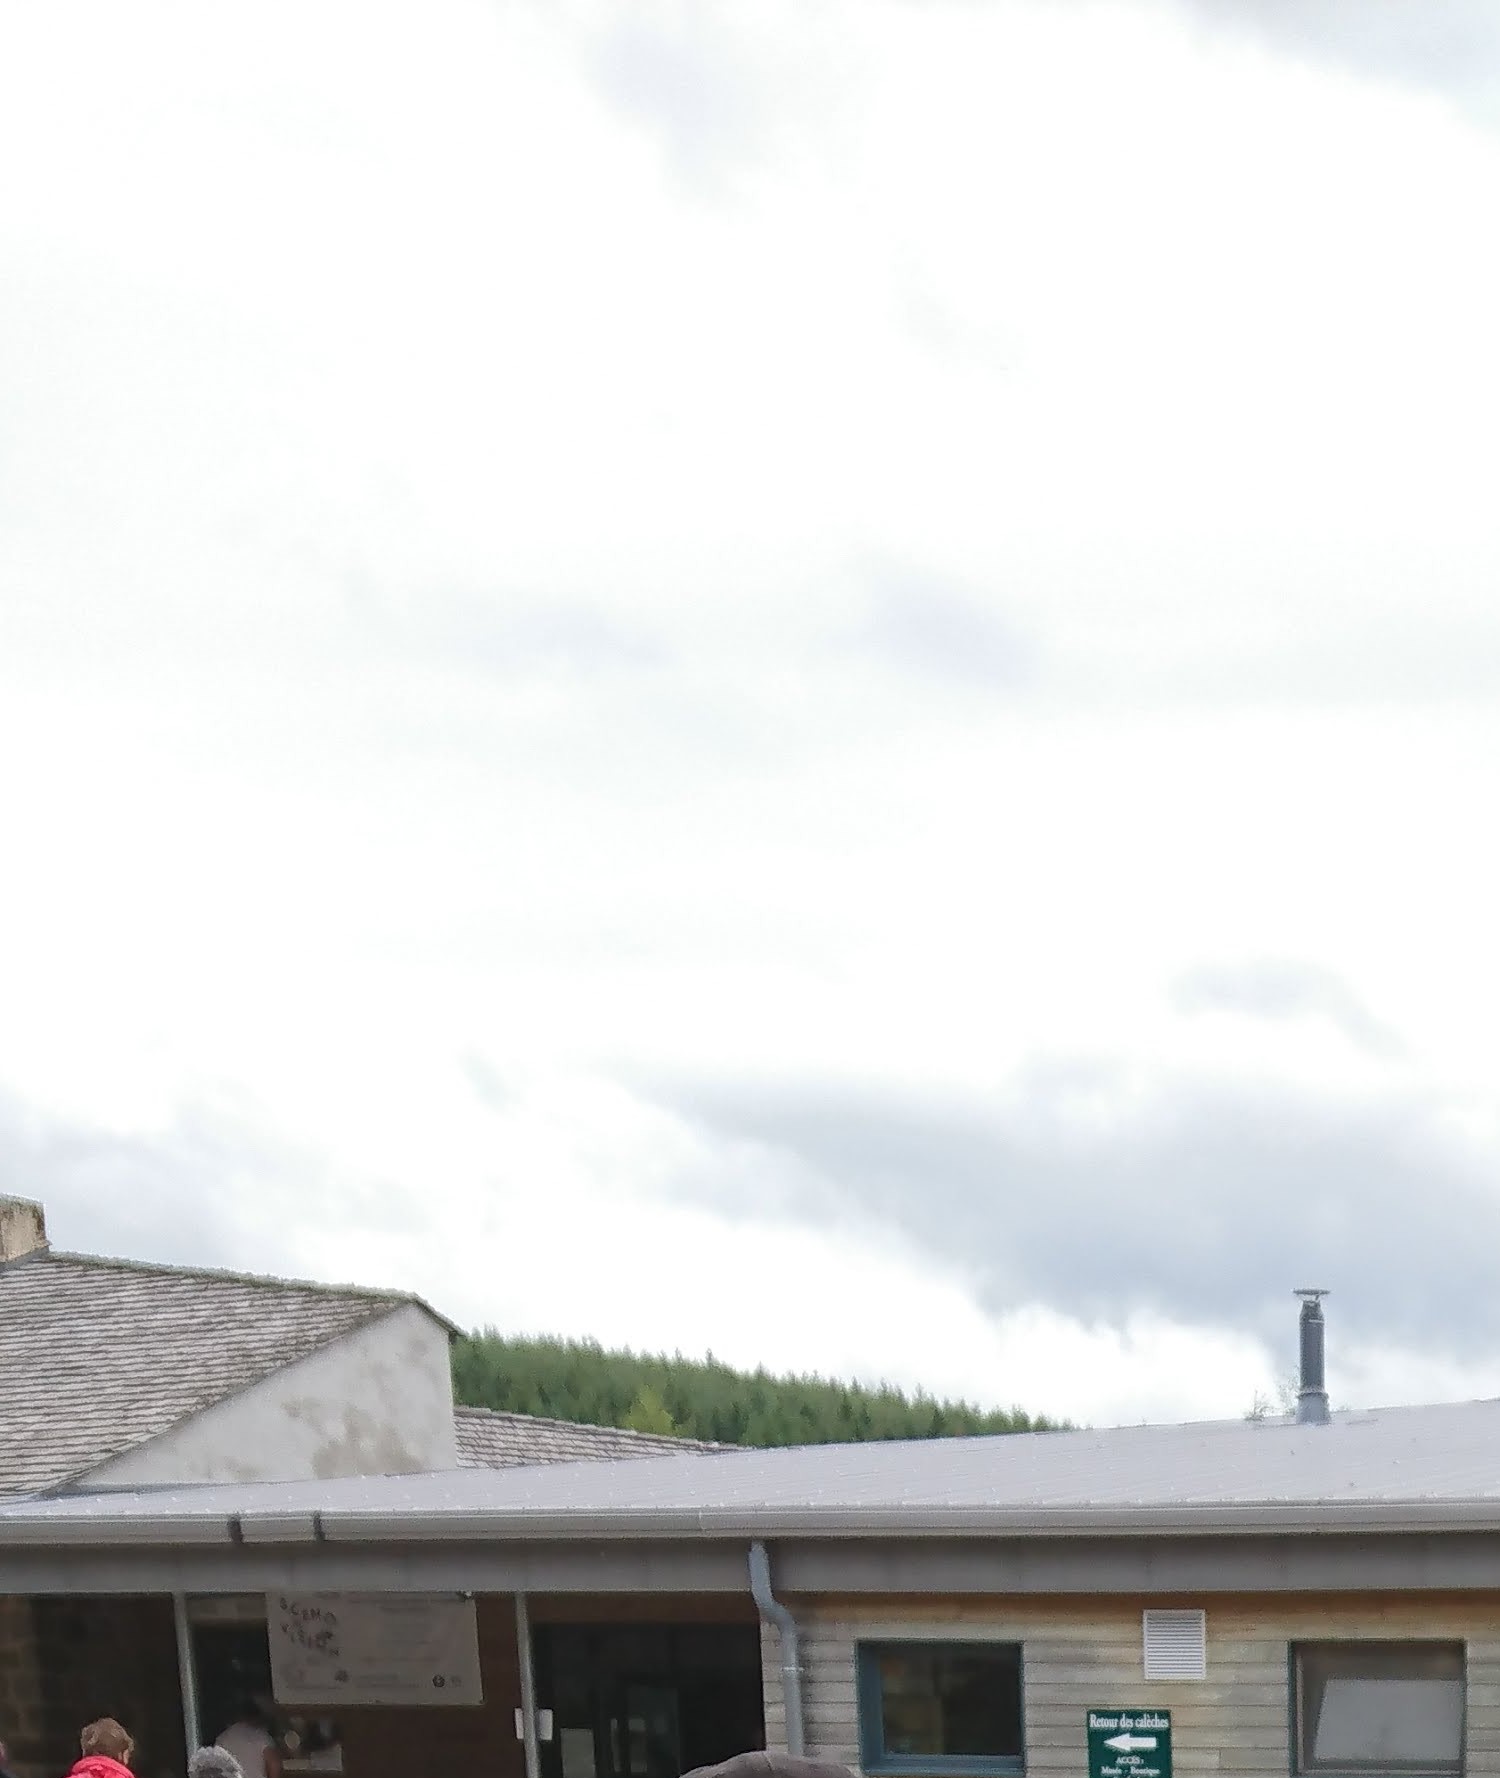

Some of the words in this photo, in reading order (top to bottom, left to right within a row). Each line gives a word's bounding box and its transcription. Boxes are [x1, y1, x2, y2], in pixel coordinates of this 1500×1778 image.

[1090, 1714, 1118, 1728] Retour
[1120, 1713, 1134, 1728] des
[1135, 1713, 1169, 1728] calèches
[1130, 1766, 1161, 1776] Boutique
